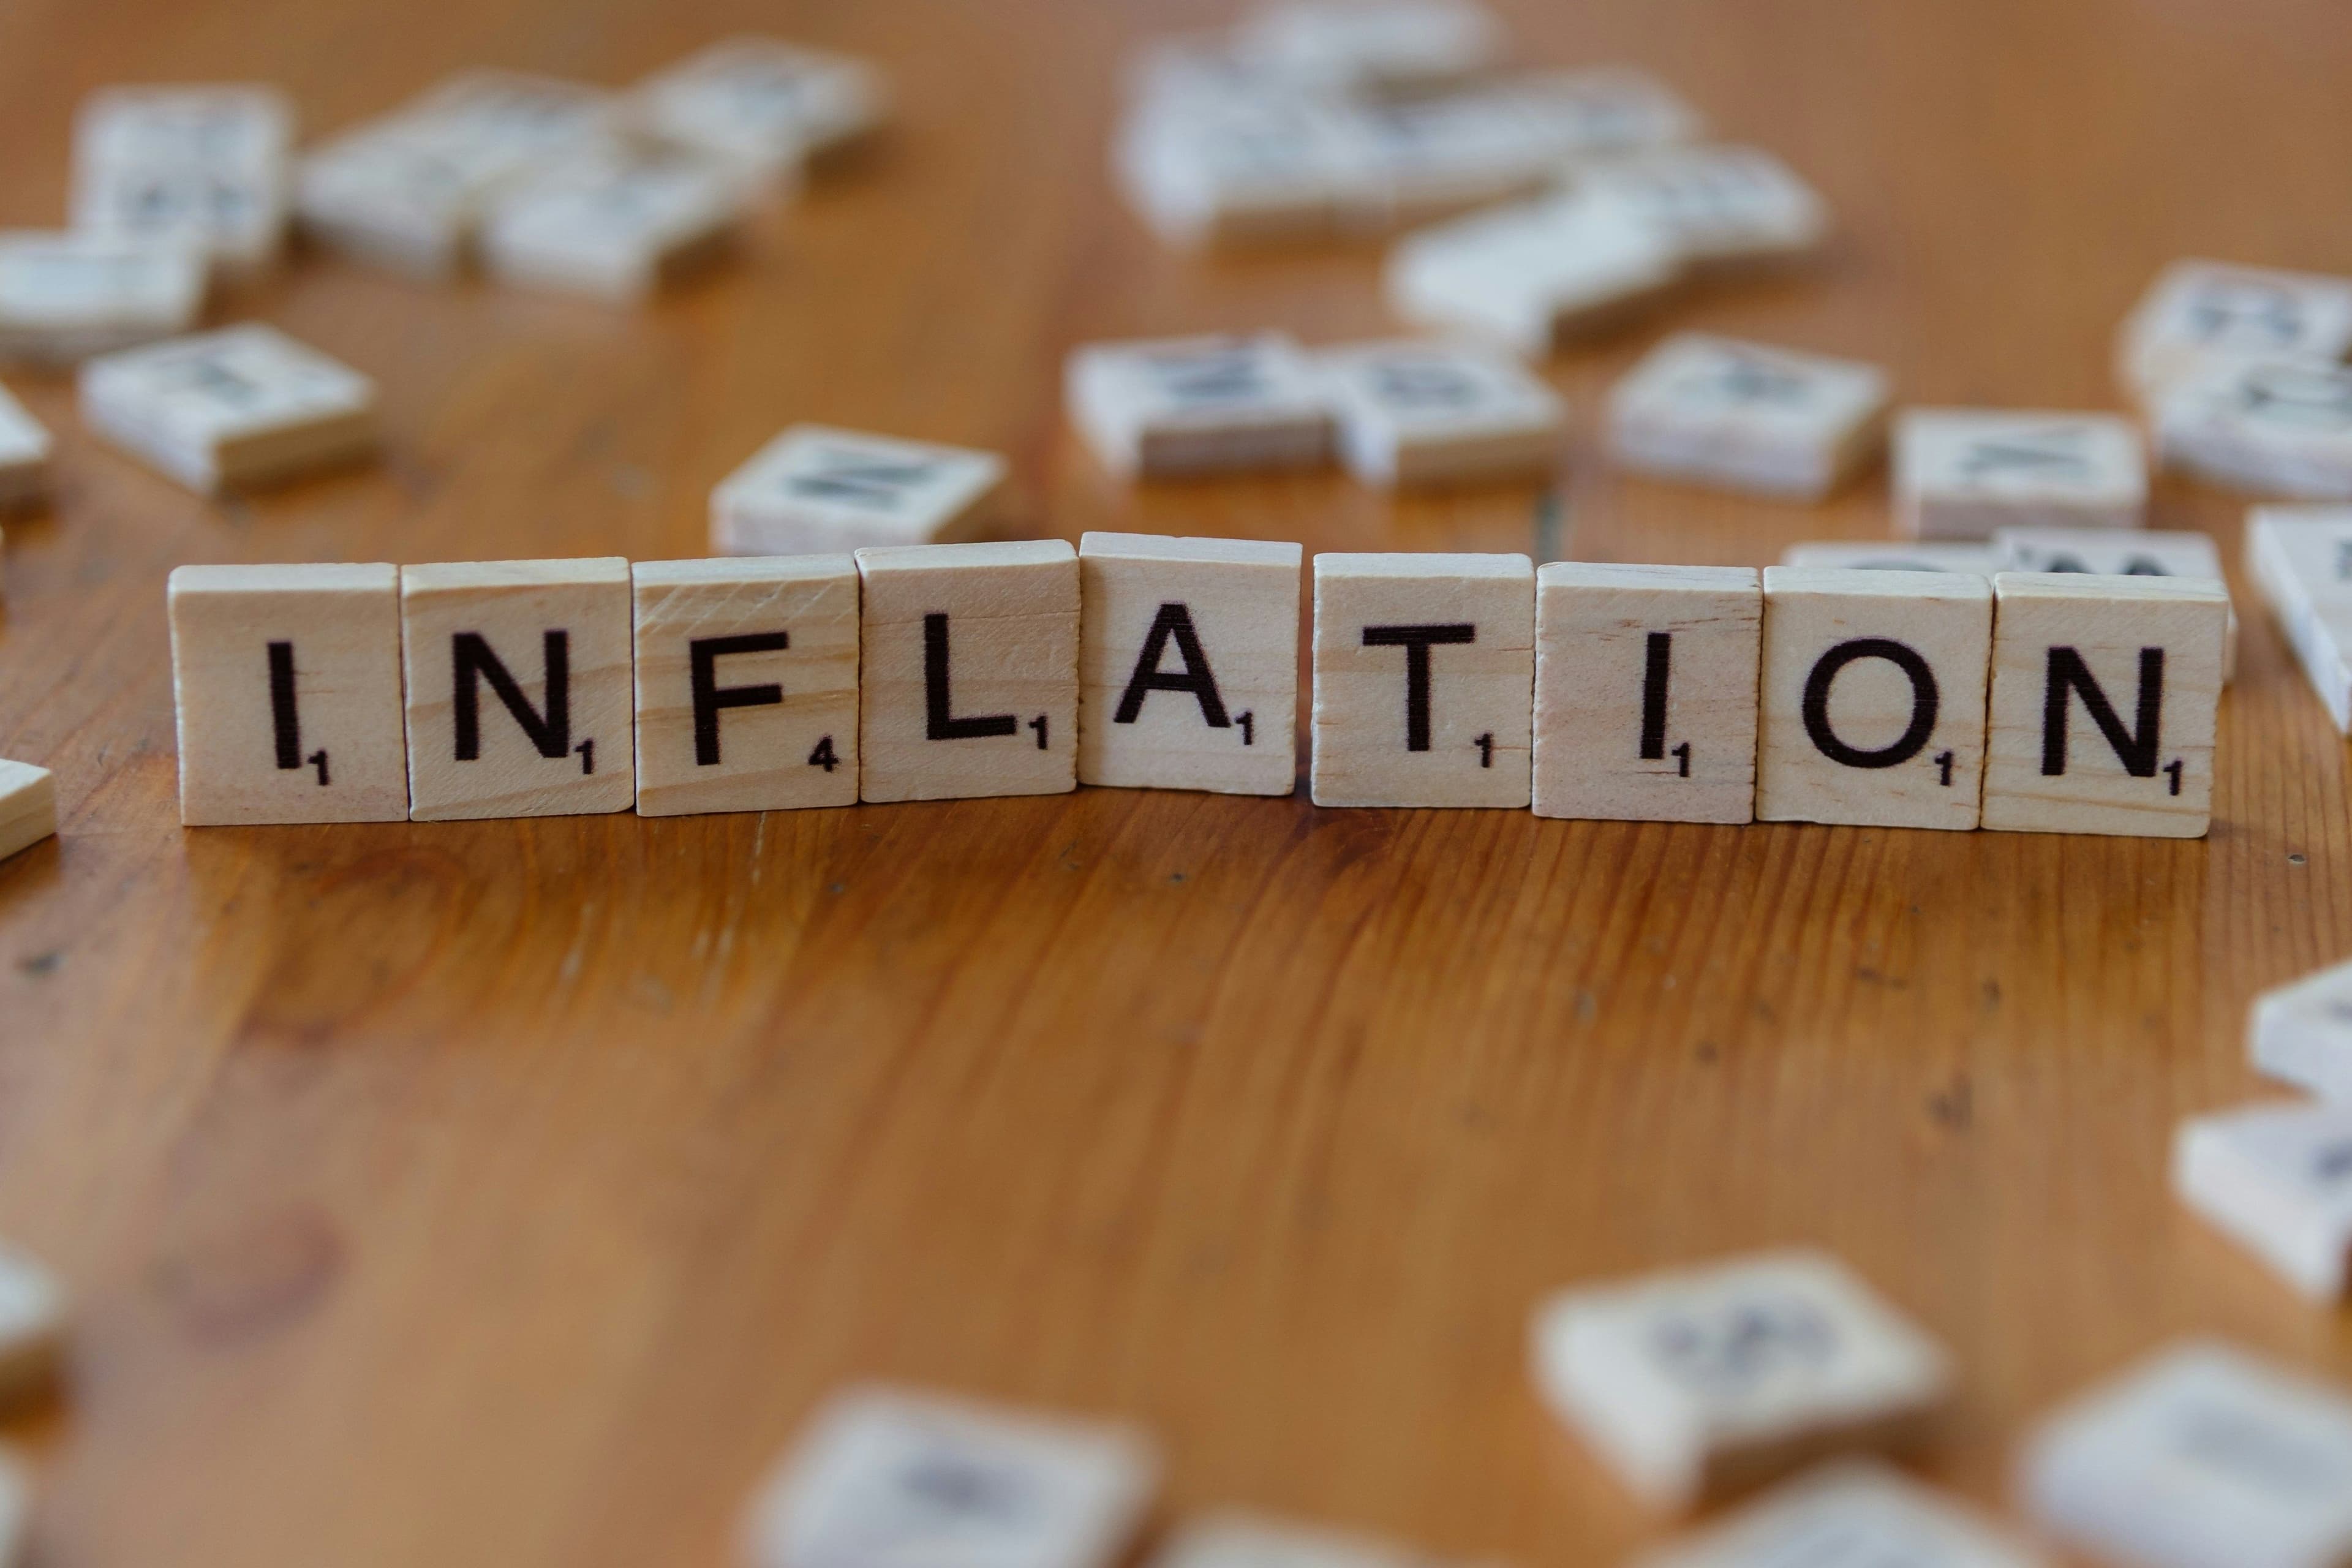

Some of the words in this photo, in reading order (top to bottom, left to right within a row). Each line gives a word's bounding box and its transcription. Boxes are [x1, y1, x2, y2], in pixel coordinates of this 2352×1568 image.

[265, 602, 2166, 778] INFLATION
[1026, 711, 1050, 752] 1
[1234, 710, 1255, 747] 1
[305, 748, 333, 788] 1
[572, 737, 597, 776] 1
[805, 734, 843, 775] 4
[1472, 732, 1498, 769] 1
[1668, 741, 1692, 778] 1
[1933, 750, 1955, 788] 1
[2162, 759, 2184, 797] 1
